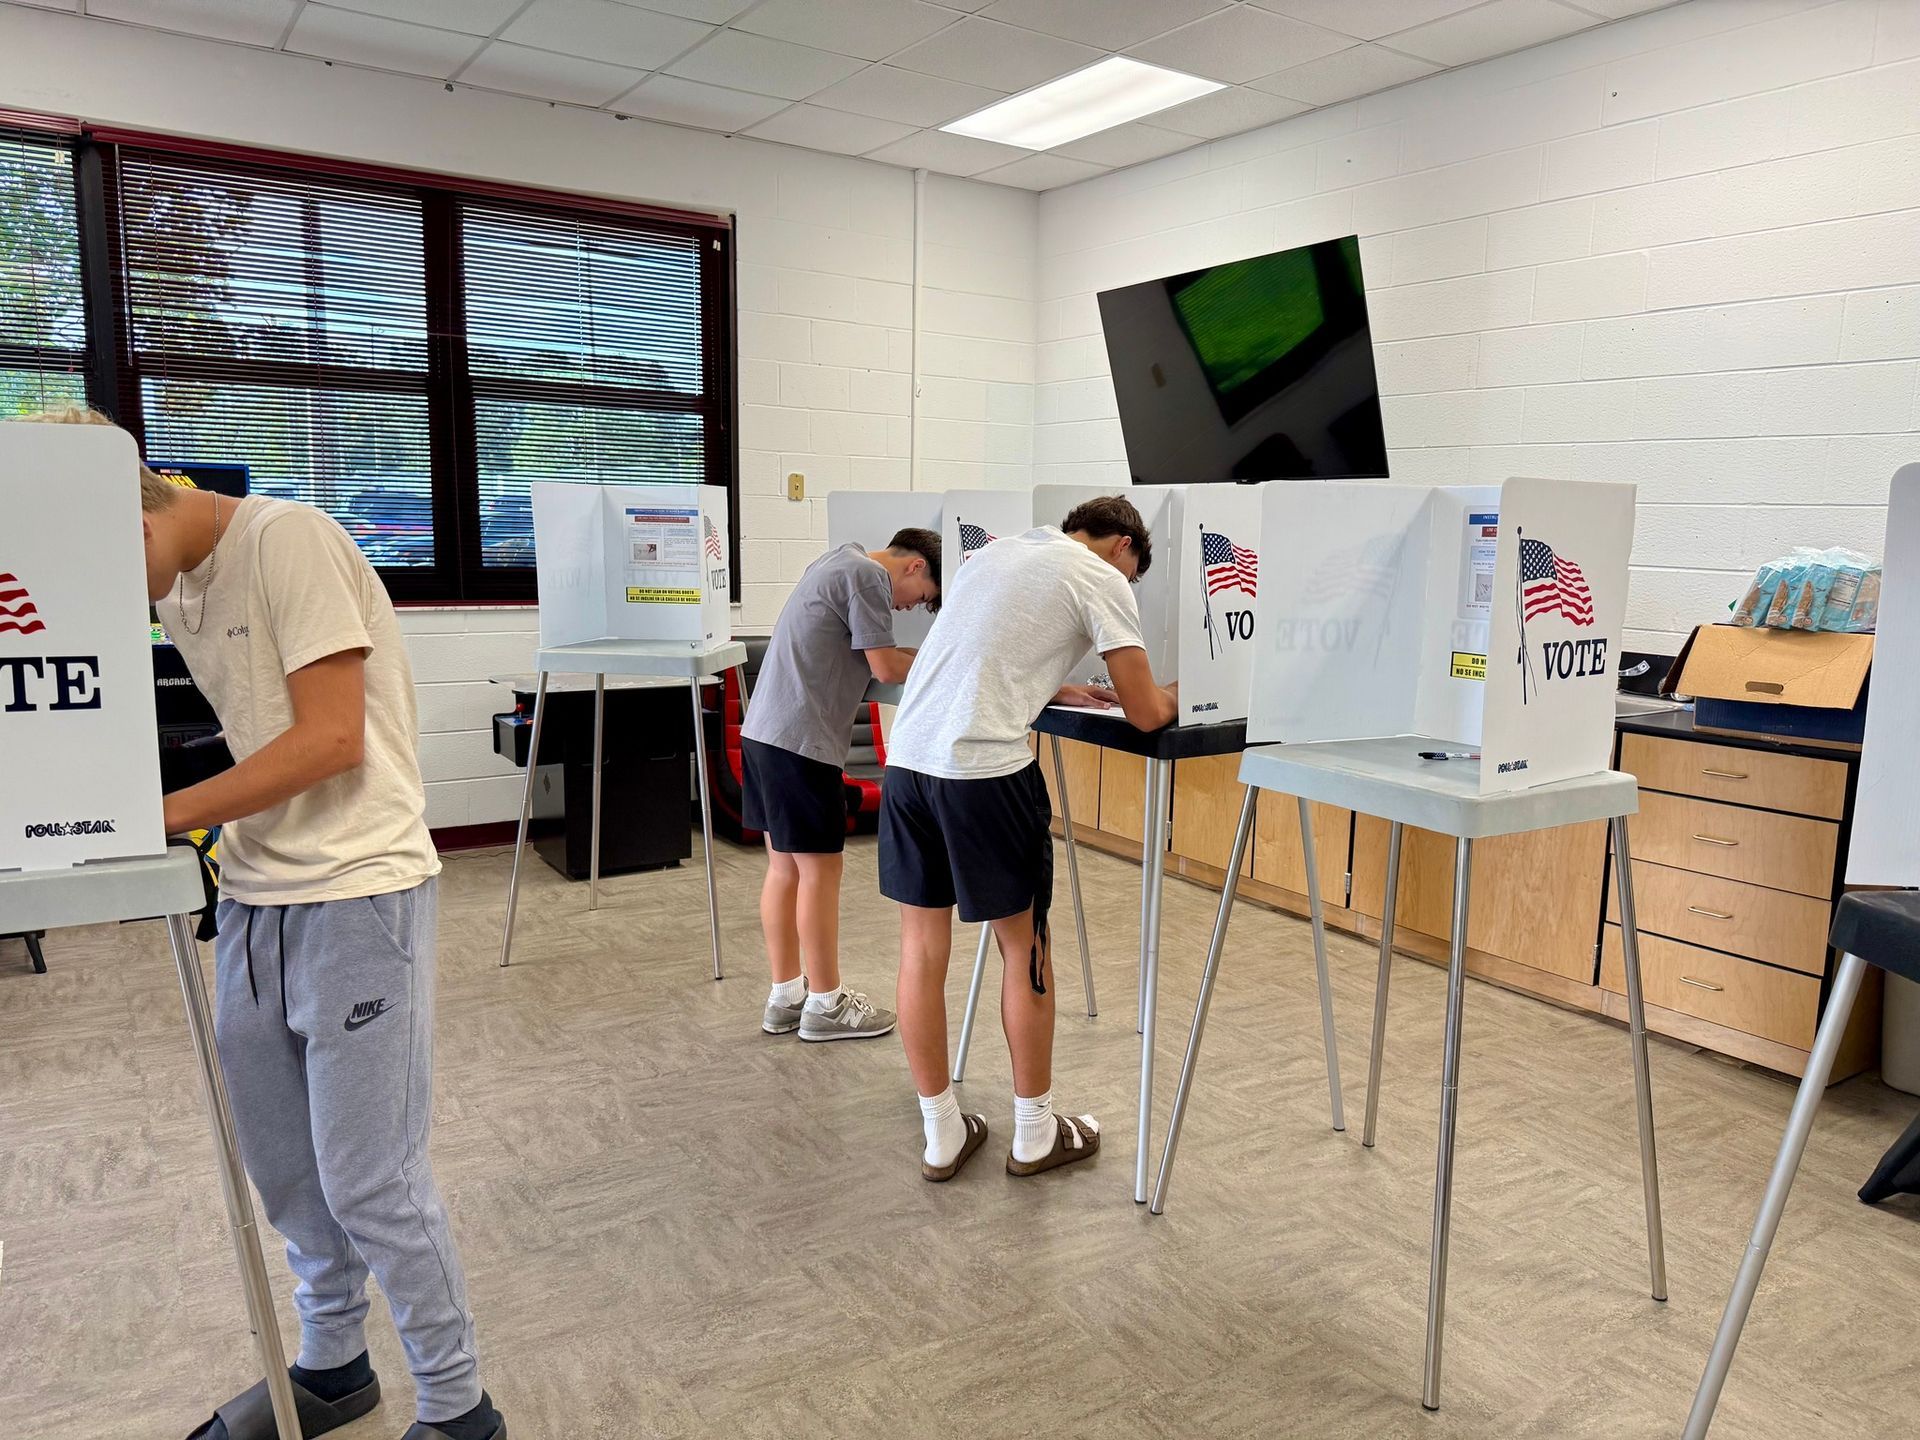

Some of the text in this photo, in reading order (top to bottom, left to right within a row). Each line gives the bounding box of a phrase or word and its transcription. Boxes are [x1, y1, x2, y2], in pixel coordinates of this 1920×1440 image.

[711, 568, 727, 591] VOTE
[1225, 610, 1255, 641] VO
[1472, 657, 1480, 665] DO
[1543, 638, 1607, 680] VOTE
[156, 677, 192, 687] ARCADE
[1464, 669, 1471, 677] SE
[351, 998, 386, 1019] NIKE
